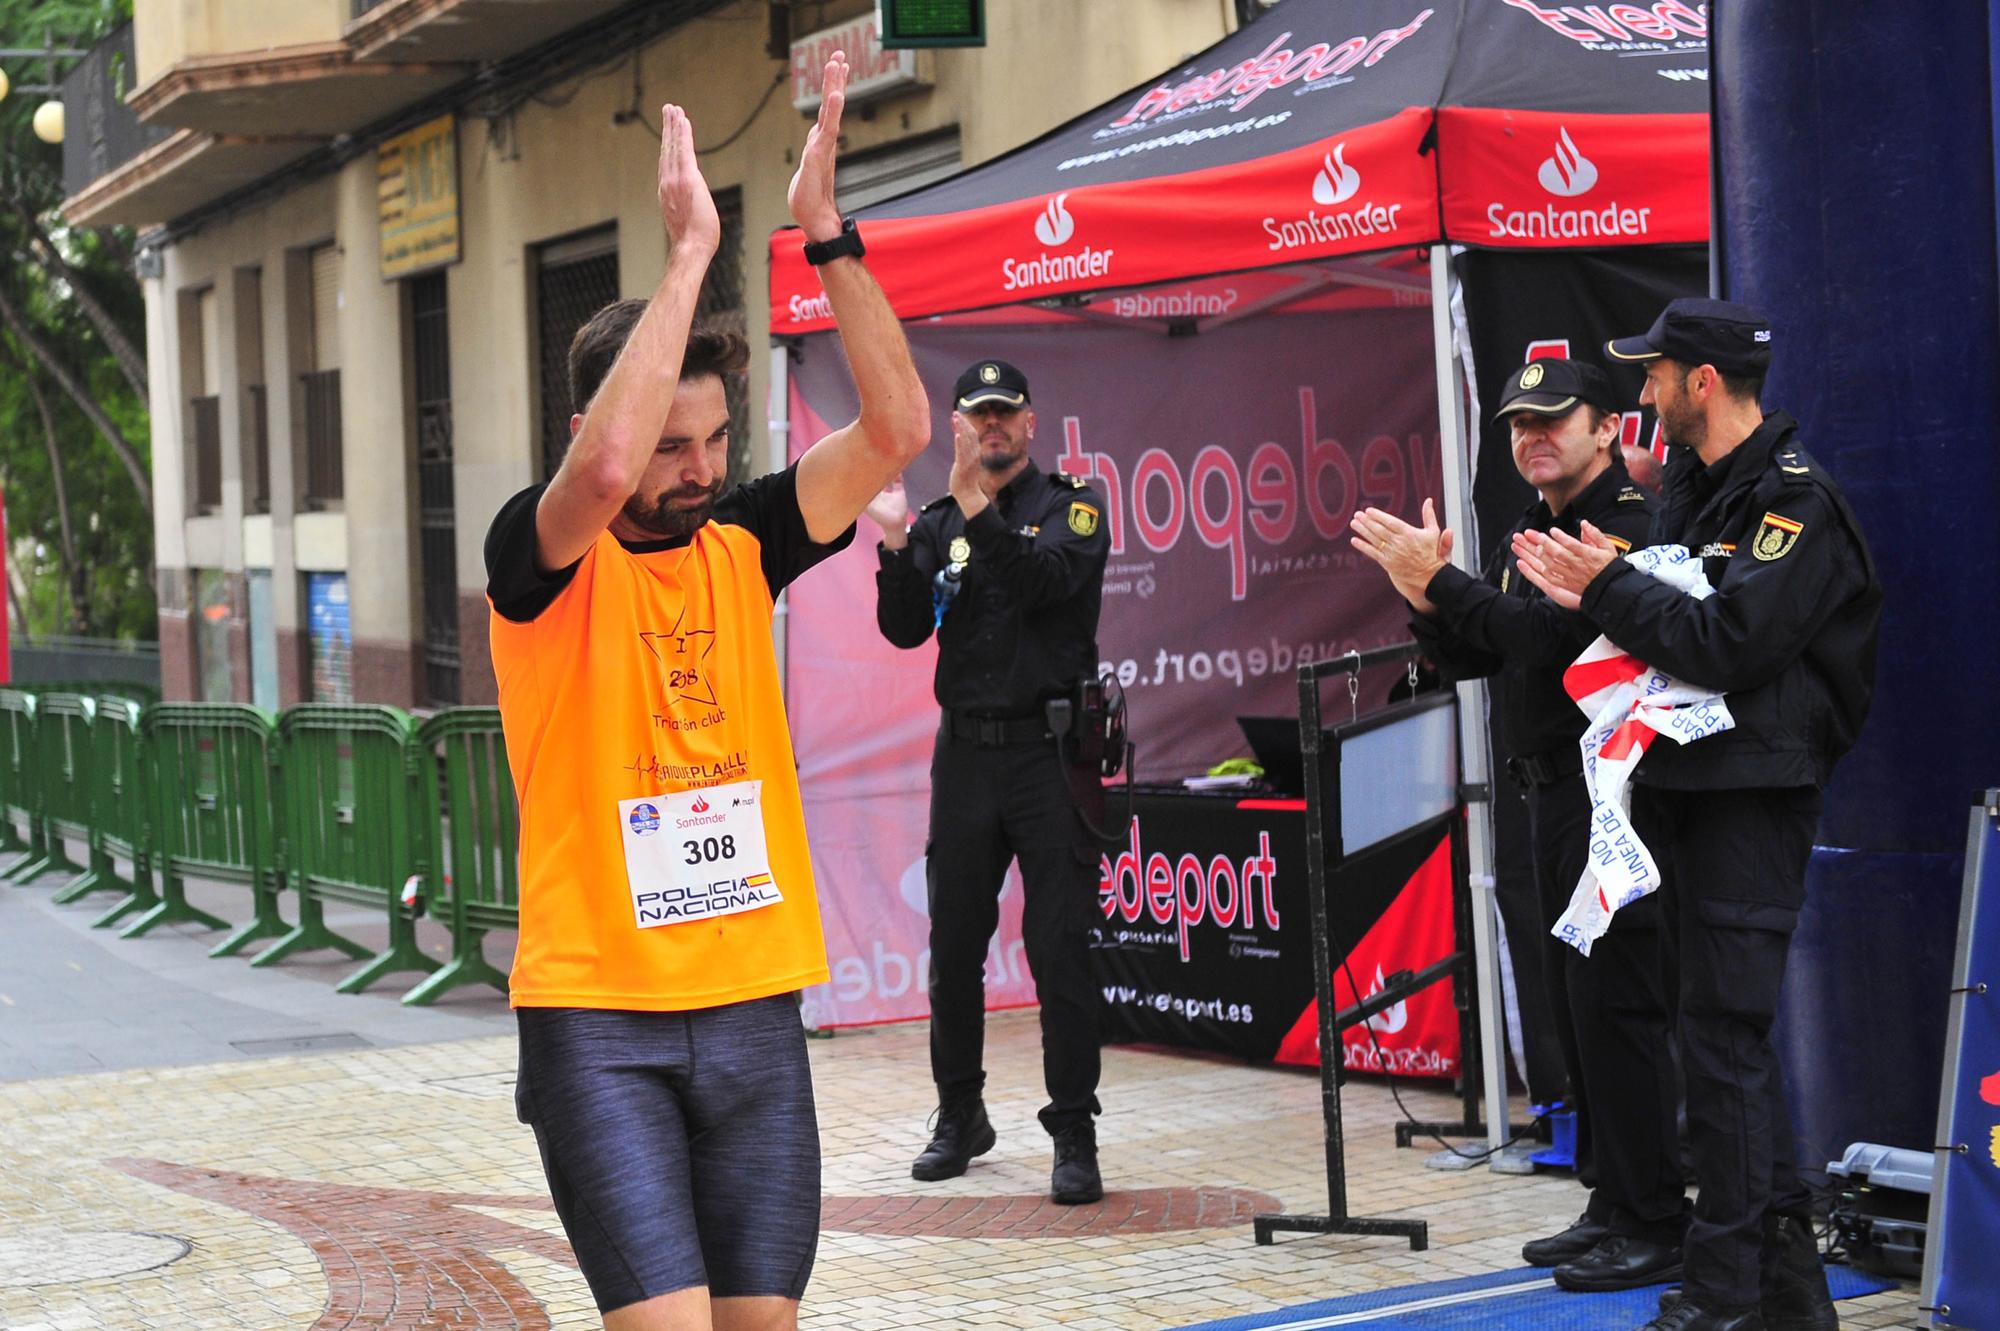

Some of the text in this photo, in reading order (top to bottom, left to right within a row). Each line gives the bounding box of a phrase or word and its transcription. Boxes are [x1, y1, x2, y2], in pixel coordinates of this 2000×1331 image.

[1263, 201, 1401, 251] Santander
[1488, 201, 1650, 238] Santander
[1002, 247, 1114, 290] Santander
[676, 813, 727, 829] Santander
[1596, 808, 1622, 834] DE
[683, 834, 736, 865] 308
[1591, 840, 1617, 866] NO
[1614, 833, 1649, 883] LINEA
[637, 878, 749, 907] POLICIA
[640, 889, 779, 922] NACIONAL
